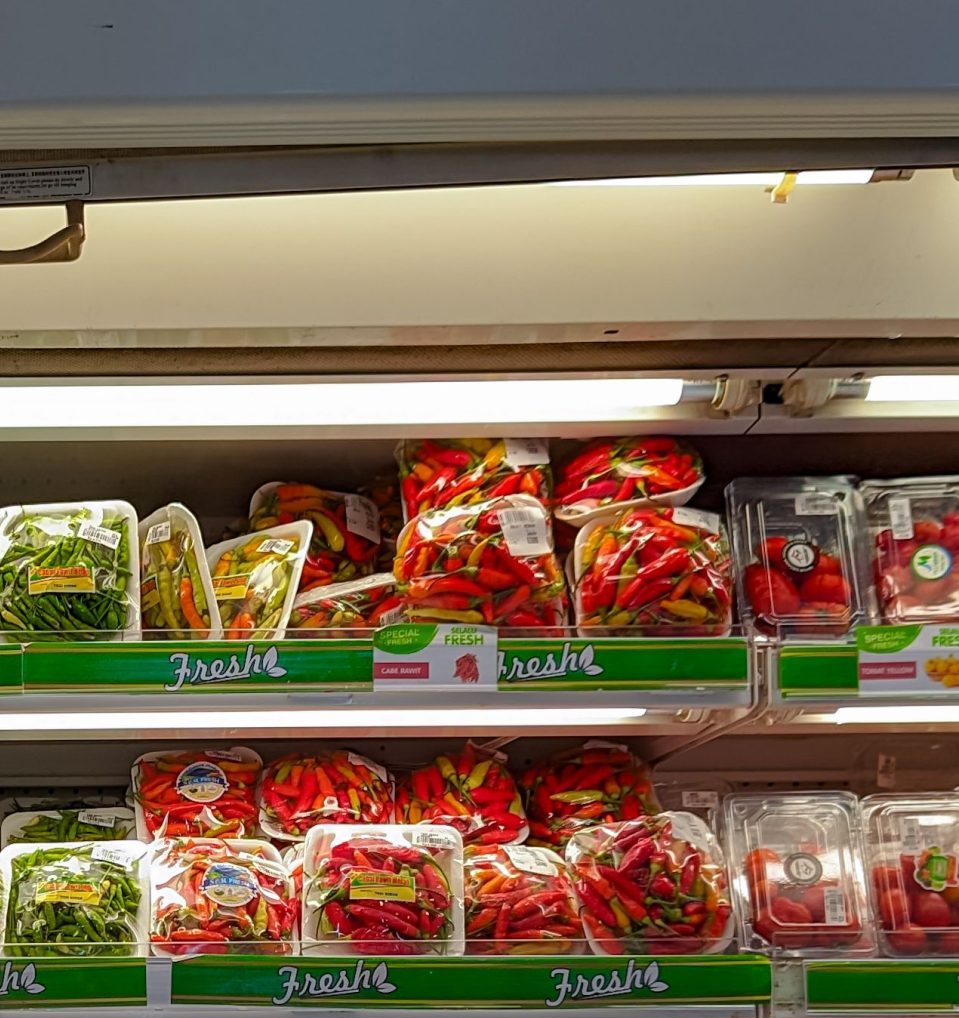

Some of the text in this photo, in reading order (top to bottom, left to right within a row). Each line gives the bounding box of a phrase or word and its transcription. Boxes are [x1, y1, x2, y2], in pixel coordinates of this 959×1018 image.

[380, 629, 419, 640] SPECIAL
[444, 634, 484, 646] FRESH
[864, 631, 906, 643] SPECIAL
[164, 641, 263, 691] Fresh
[498, 642, 581, 681] resh
[272, 960, 371, 1005] Fresh
[545, 960, 644, 1006] Fresh
